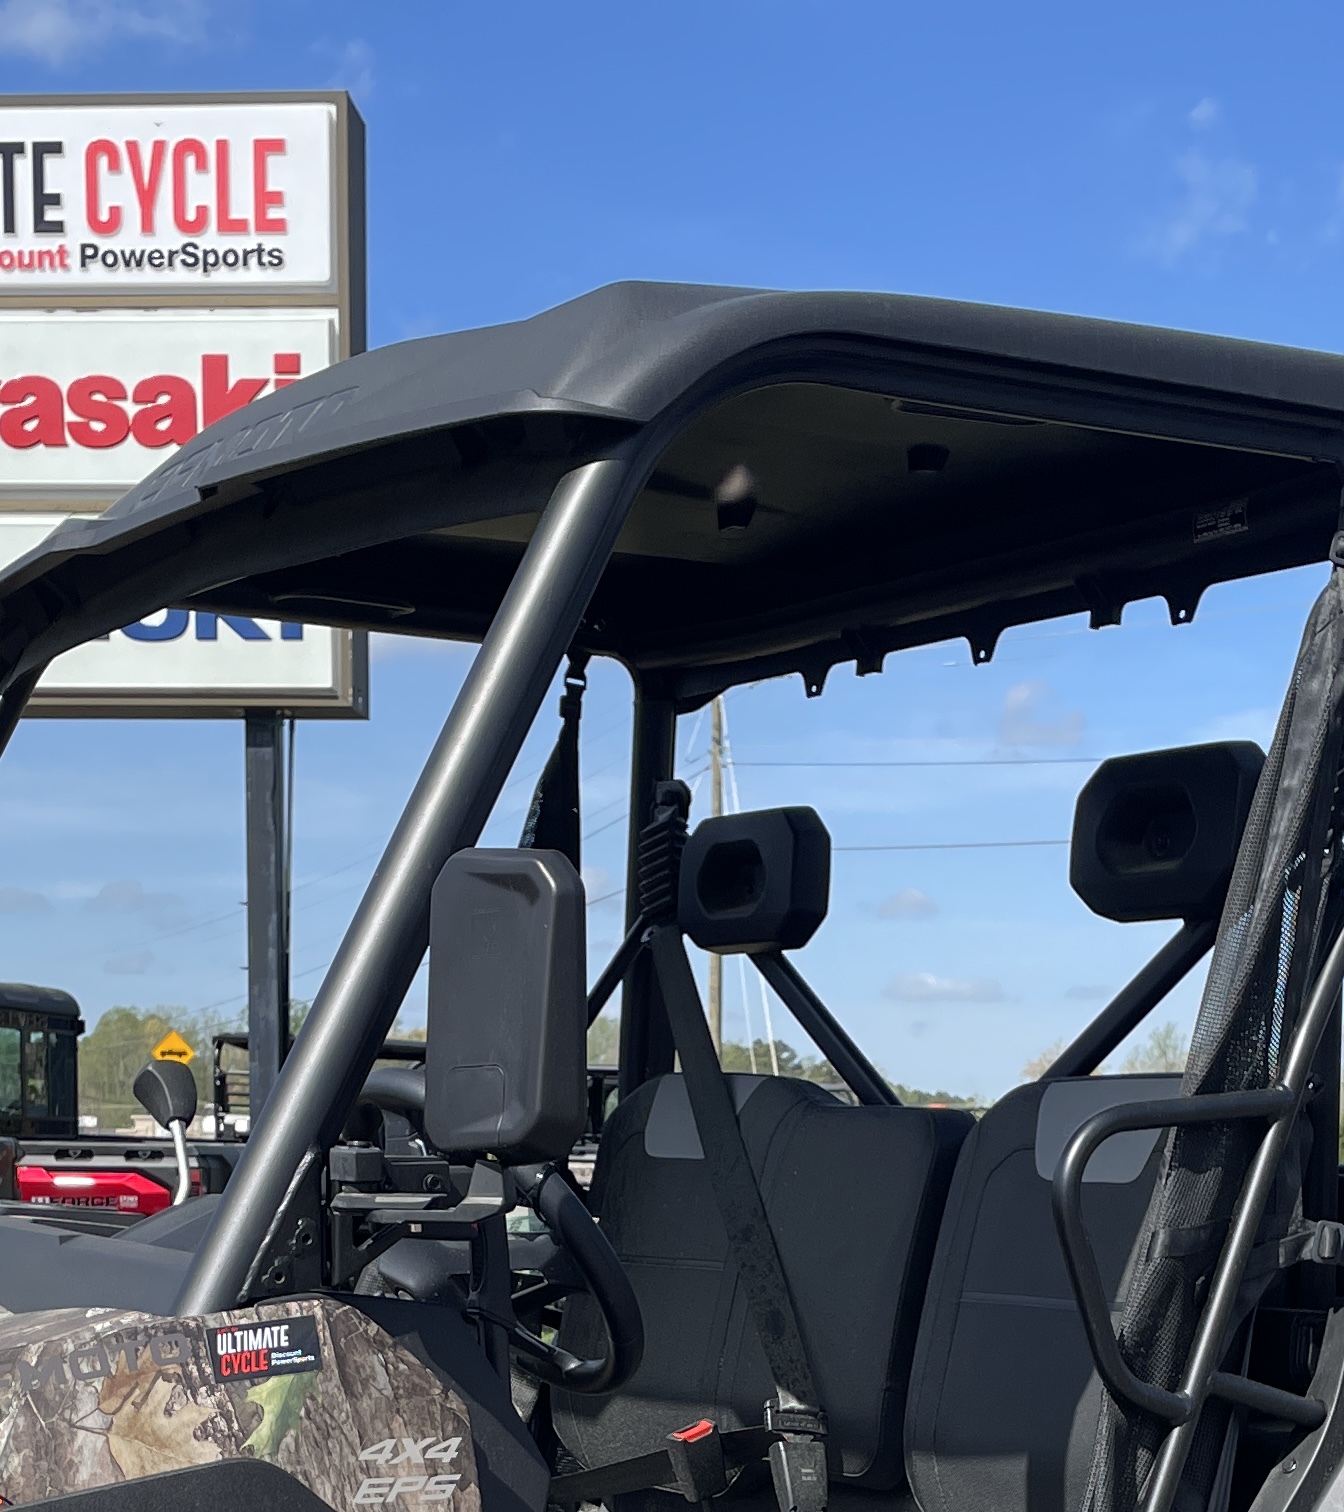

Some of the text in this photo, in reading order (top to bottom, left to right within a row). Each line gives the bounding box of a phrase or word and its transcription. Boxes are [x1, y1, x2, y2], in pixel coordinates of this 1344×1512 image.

[83, 137, 288, 237] CYCLE
[78, 242, 285, 274] PowerSports
[217, 1325, 290, 1355] ULTIMATE
[220, 1348, 269, 1376] CYCLE
[358, 1436, 462, 1465] 4X4
[353, 1474, 462, 1504] EPS
